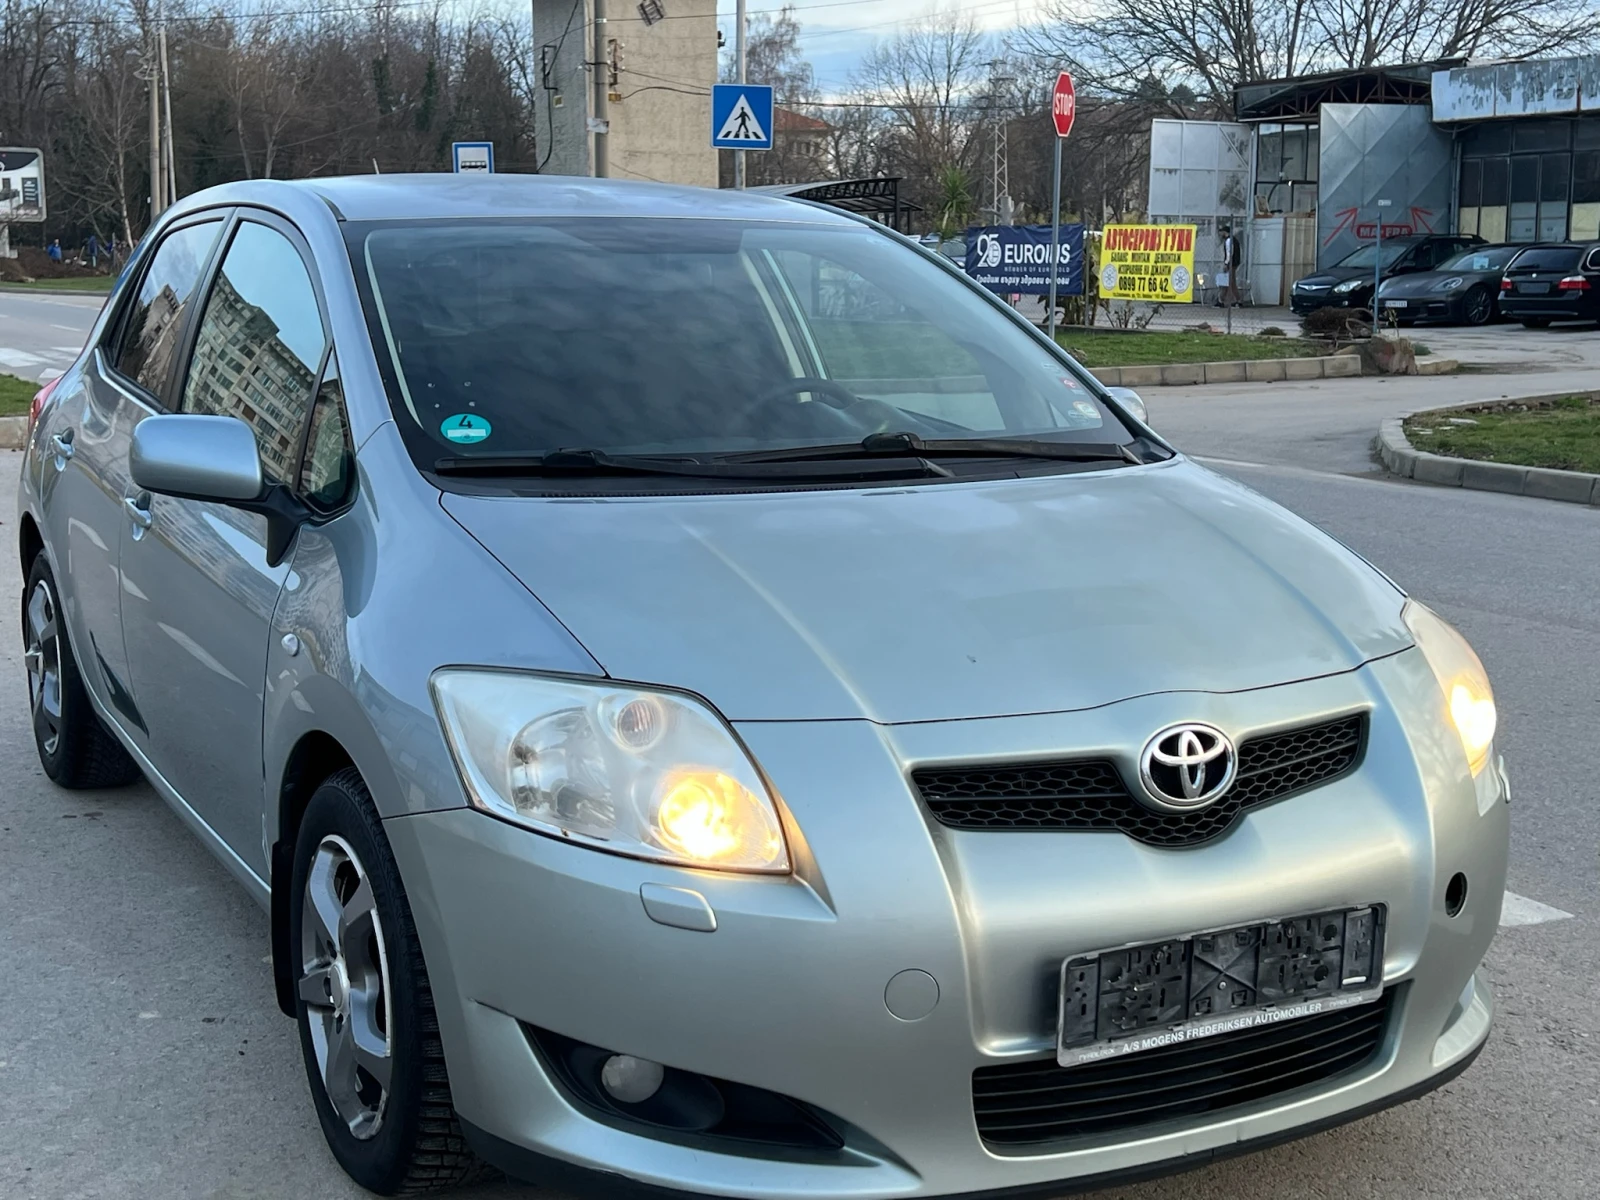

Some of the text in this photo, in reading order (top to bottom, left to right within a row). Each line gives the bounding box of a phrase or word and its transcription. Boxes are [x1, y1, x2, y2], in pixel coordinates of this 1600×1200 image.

[1055, 92, 1073, 116] STOP
[1104, 228, 1193, 252] АВТОСЕРВИЗ ГУМИ
[1110, 252, 1181, 264] БАЛАНС МОНТАЖ ДЕМОНТАЖ
[1119, 276, 1169, 292] 0899 77 66 42
[459, 415, 473, 429] 4
[1122, 1003, 1322, 1053] A/S MOGENS FREDERIKSEN AUTOMOBILER
